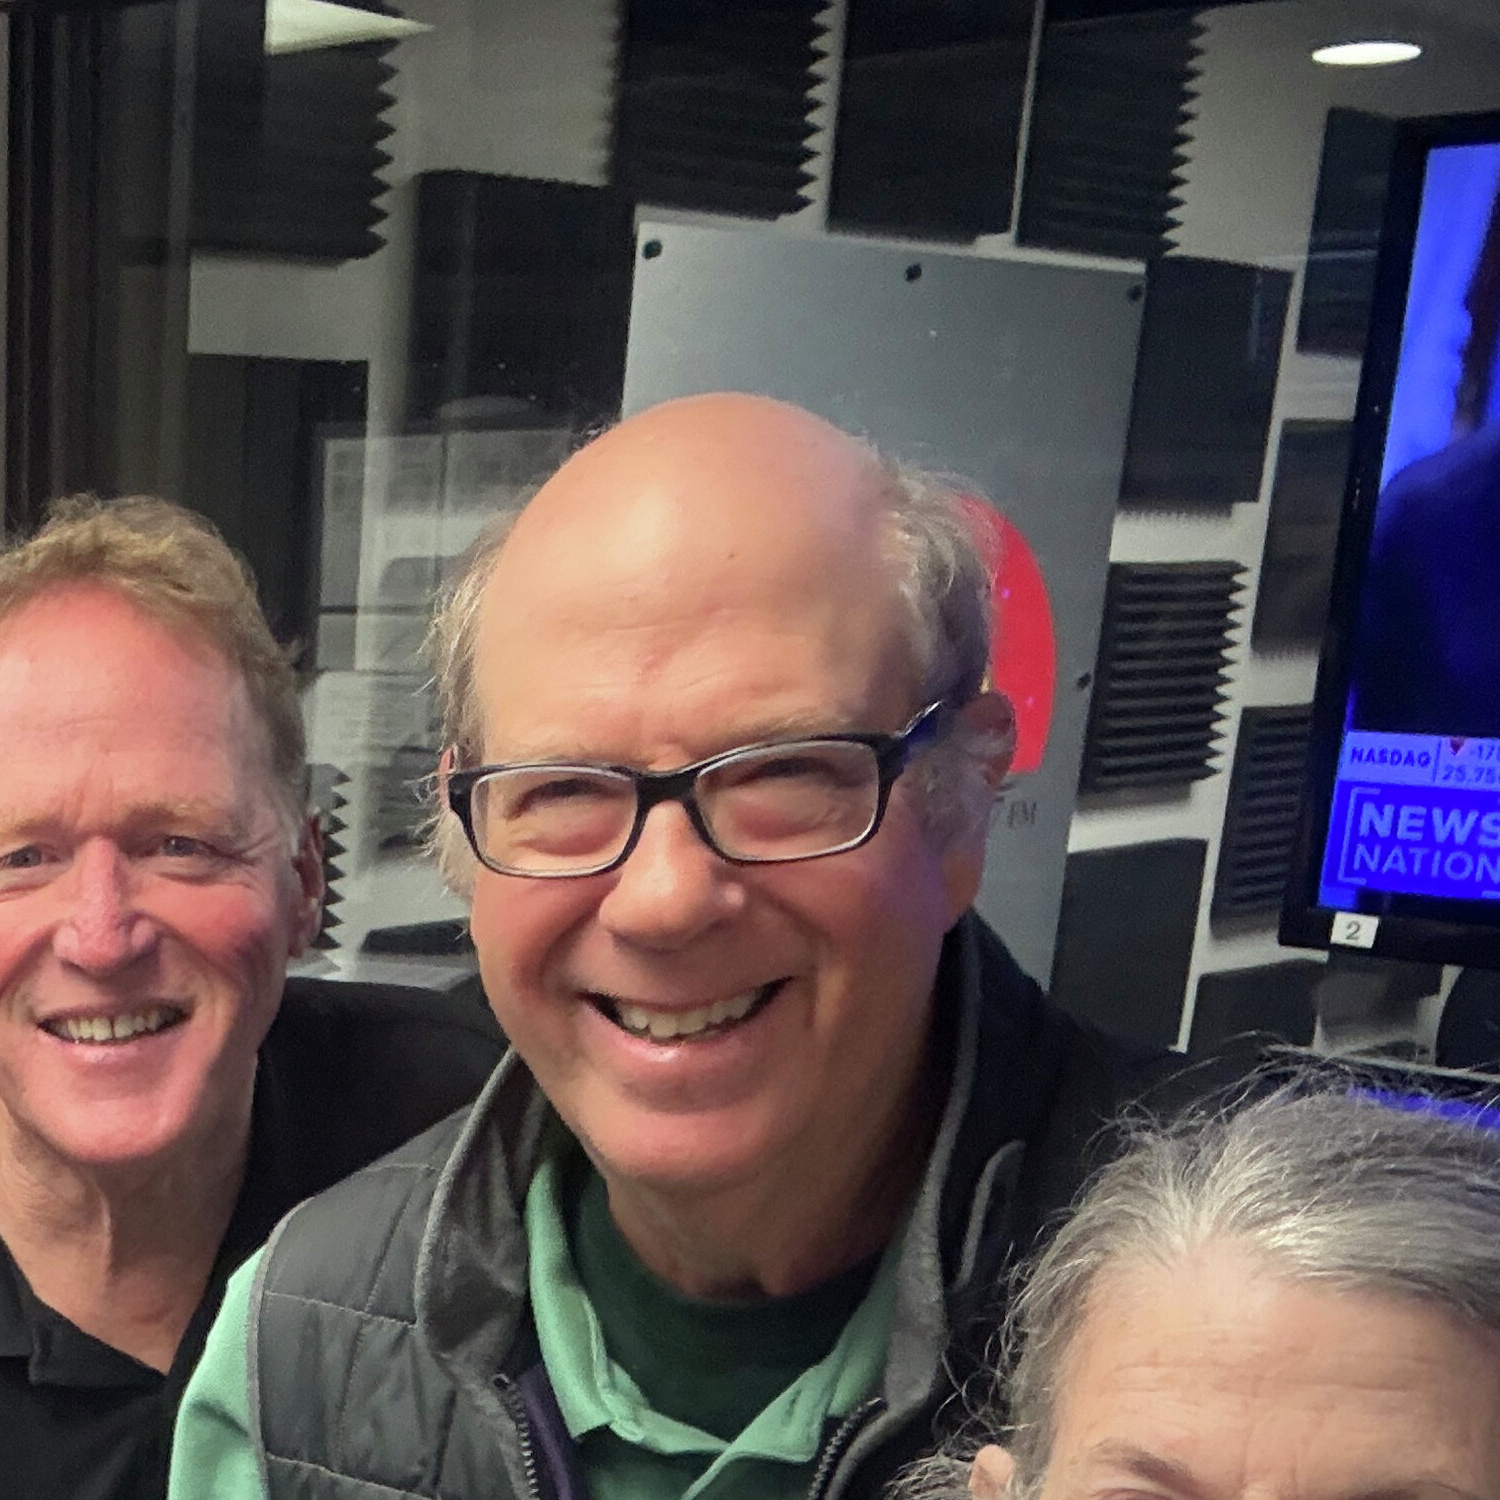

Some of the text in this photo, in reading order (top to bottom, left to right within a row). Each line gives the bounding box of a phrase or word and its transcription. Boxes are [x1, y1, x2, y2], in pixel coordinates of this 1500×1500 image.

[1350, 747, 1432, 767] NASDAQ
[1358, 802, 1500, 848] NEWS
[1353, 843, 1500, 884] NATION
[1346, 921, 1362, 940] 2
